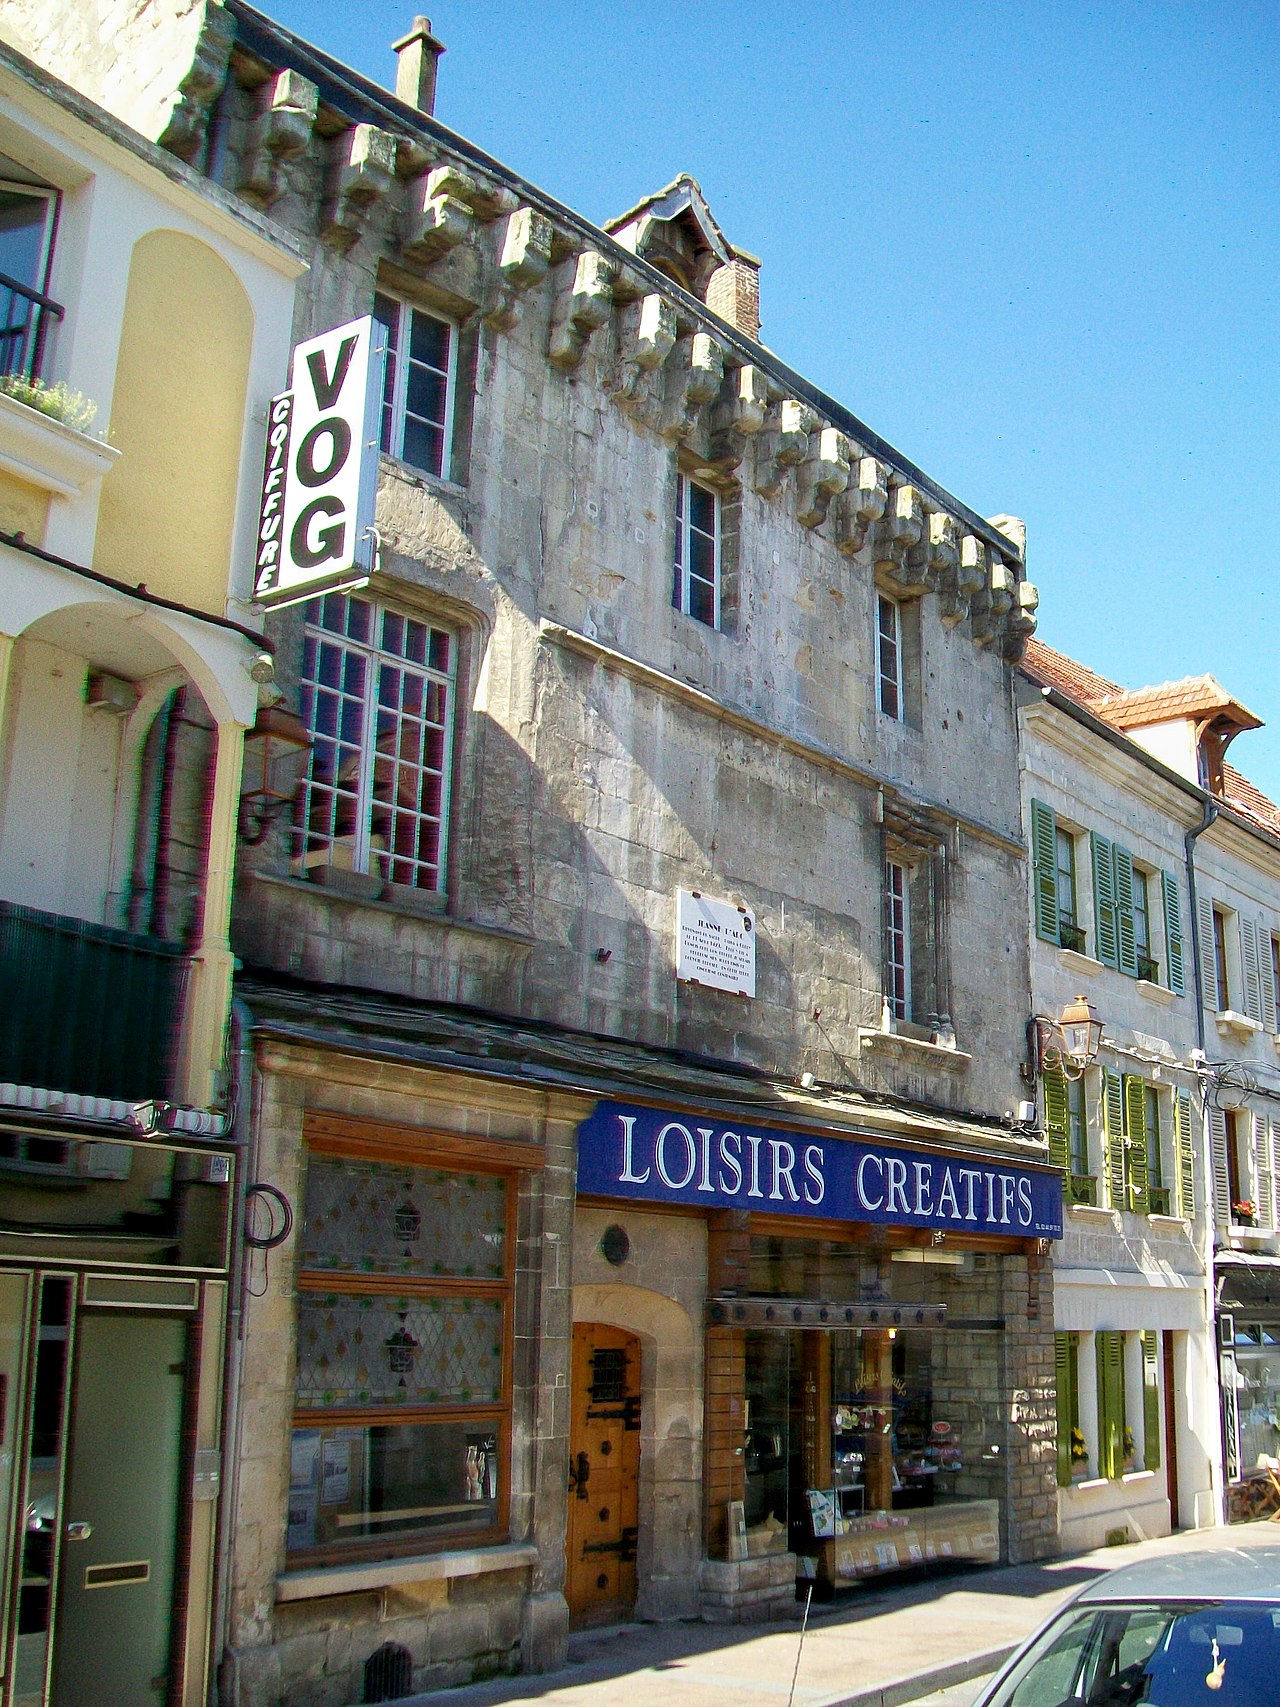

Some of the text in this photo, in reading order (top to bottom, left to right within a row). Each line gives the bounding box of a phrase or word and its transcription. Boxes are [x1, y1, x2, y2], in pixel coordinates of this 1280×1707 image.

[257, 399, 290, 590] COIFFURE
[290, 334, 359, 568] VOG
[618, 1115, 1033, 1225] LOISIRS CREATIFS
